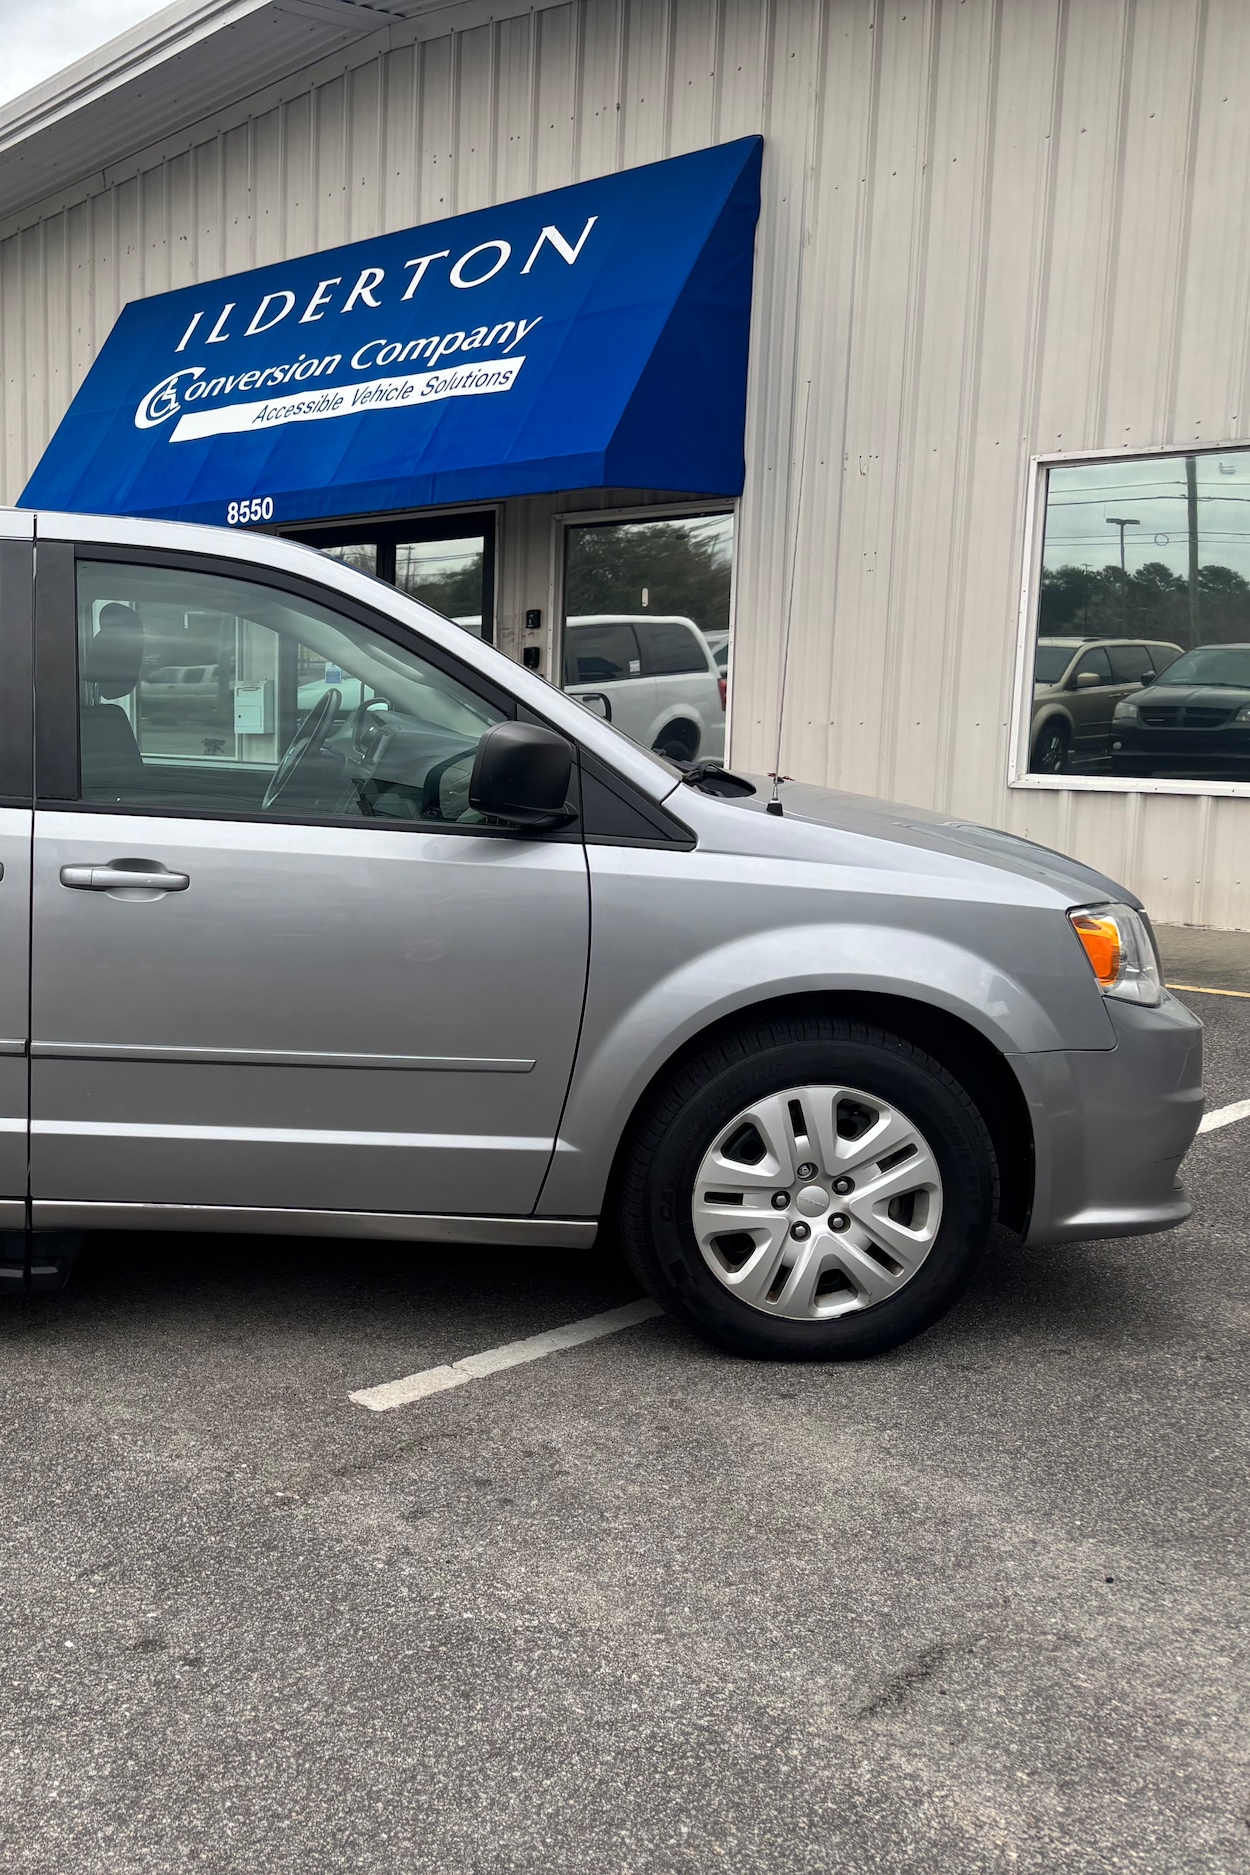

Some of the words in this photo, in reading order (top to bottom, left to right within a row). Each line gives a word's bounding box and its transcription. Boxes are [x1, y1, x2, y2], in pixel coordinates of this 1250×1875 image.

[174, 215, 599, 353] ILDERTON
[134, 353, 343, 430] Conversion
[349, 315, 544, 371] Company
[251, 396, 345, 425] Accessible
[350, 379, 415, 408] Vehicle
[420, 366, 514, 398] Solutions
[225, 496, 274, 526] 8550
